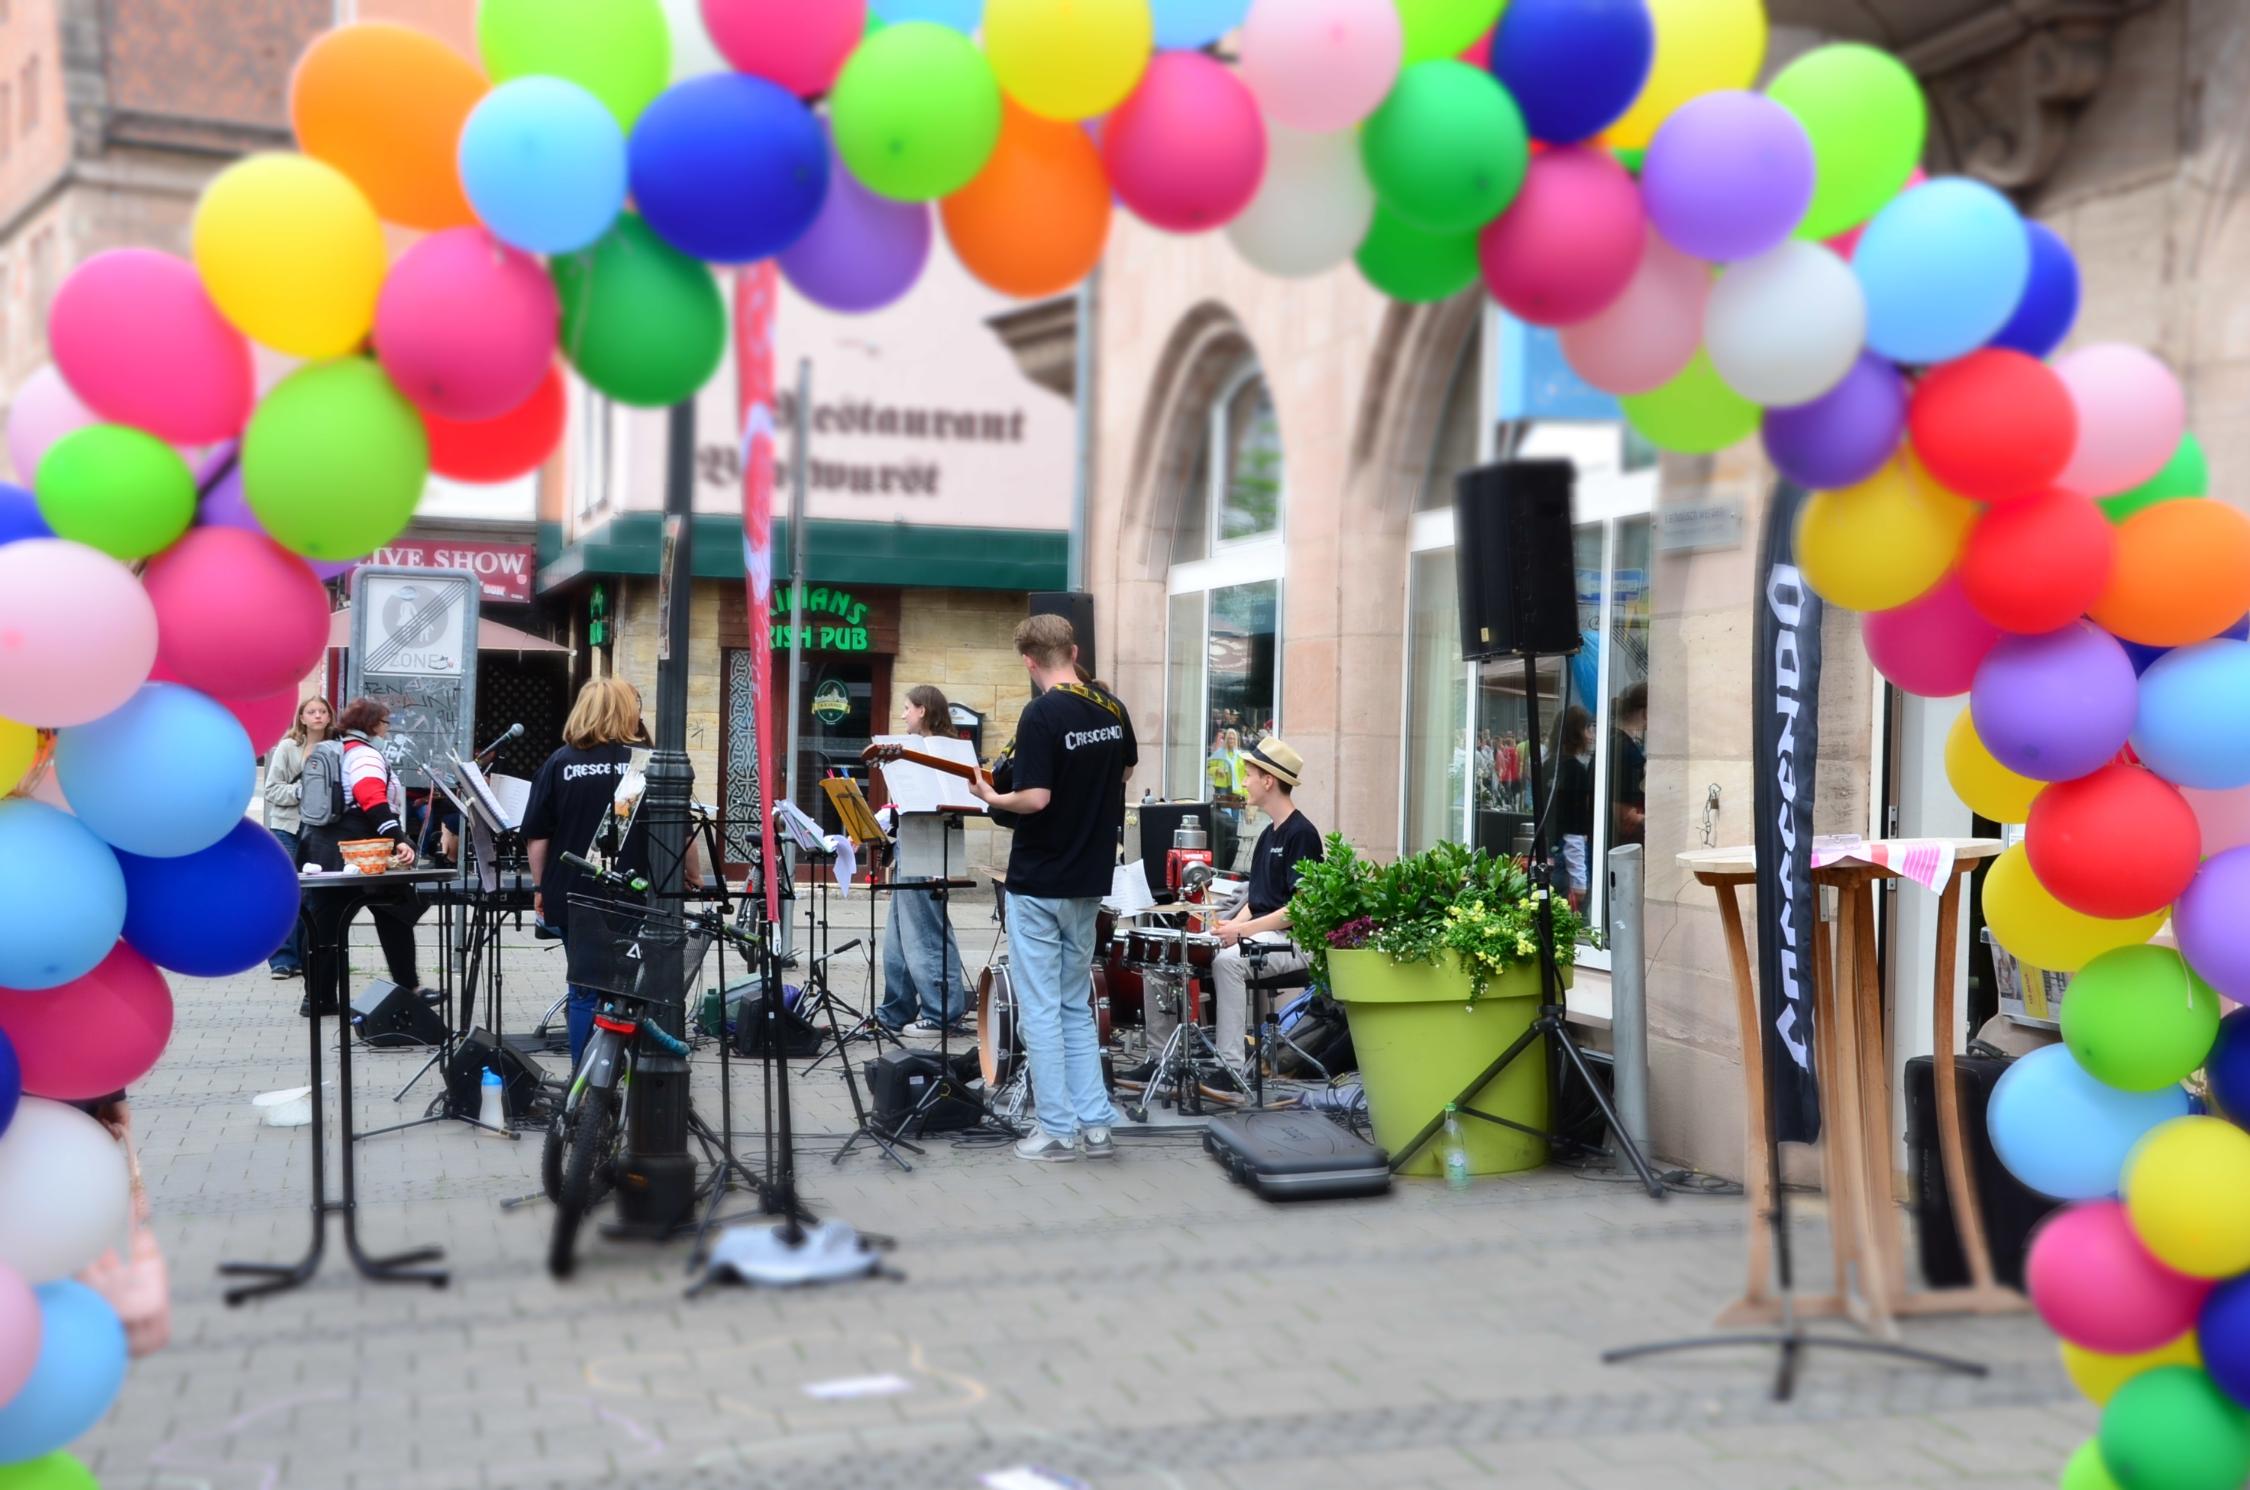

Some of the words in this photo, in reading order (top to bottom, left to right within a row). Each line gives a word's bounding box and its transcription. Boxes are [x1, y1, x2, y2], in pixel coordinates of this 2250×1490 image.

[699, 445, 940, 495] Bwurst
[433, 549, 526, 574] SHOW
[770, 582, 867, 624] ILIANS
[769, 625, 811, 649] RISH
[820, 627, 868, 650] PUB
[1065, 725, 1123, 750] CRESCEND
[563, 762, 630, 781] CRESCEND
